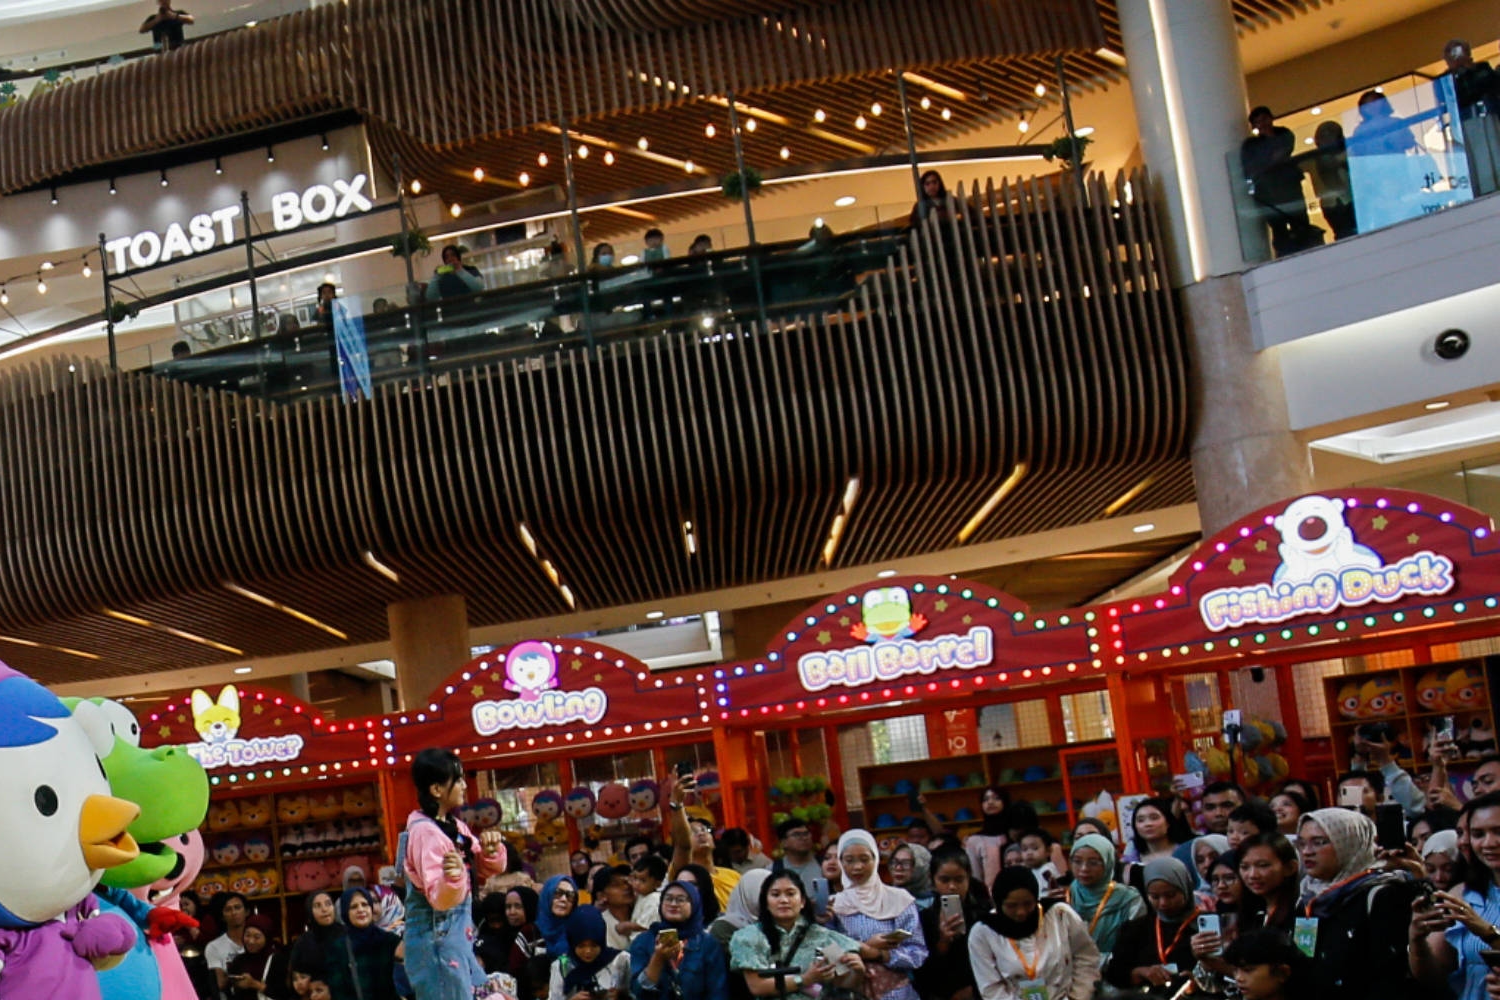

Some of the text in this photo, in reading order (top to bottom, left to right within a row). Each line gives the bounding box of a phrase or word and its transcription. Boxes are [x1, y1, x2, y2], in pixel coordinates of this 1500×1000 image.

[105, 173, 373, 274] TOAST BOX
[1205, 553, 1449, 626] Fishing Duck
[803, 630, 989, 687] Ball Barrel
[476, 690, 603, 732] Bowling
[226, 738, 299, 763] Tower
